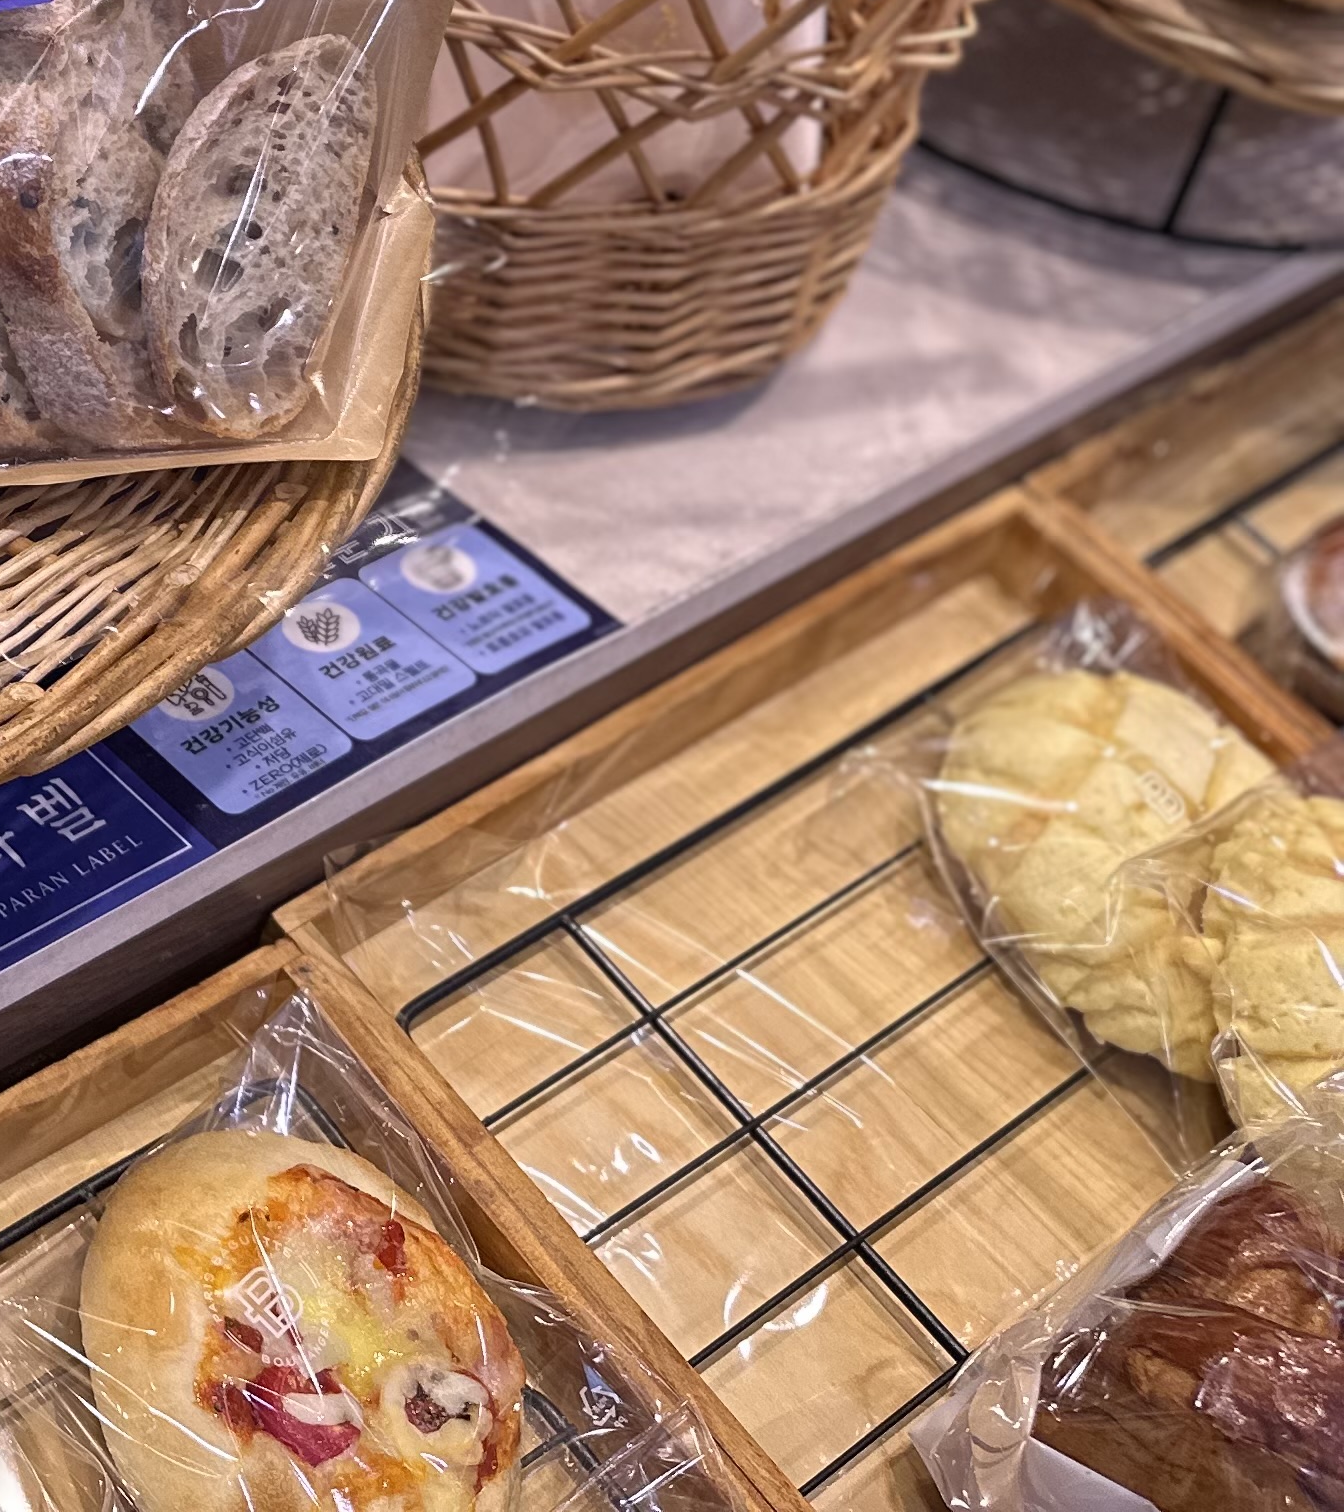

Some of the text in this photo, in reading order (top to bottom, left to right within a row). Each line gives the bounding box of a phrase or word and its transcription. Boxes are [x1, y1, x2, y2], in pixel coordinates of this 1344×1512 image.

[319, 635, 395, 680] 건강원료
[176, 694, 283, 757] 건강기능성
[231, 721, 275, 750] 고단백
[231, 726, 298, 766] 고식이섬유
[245, 742, 330, 792] ZERO(제로)
[260, 745, 292, 767] 저당
[72, 835, 143, 876] LABEL
